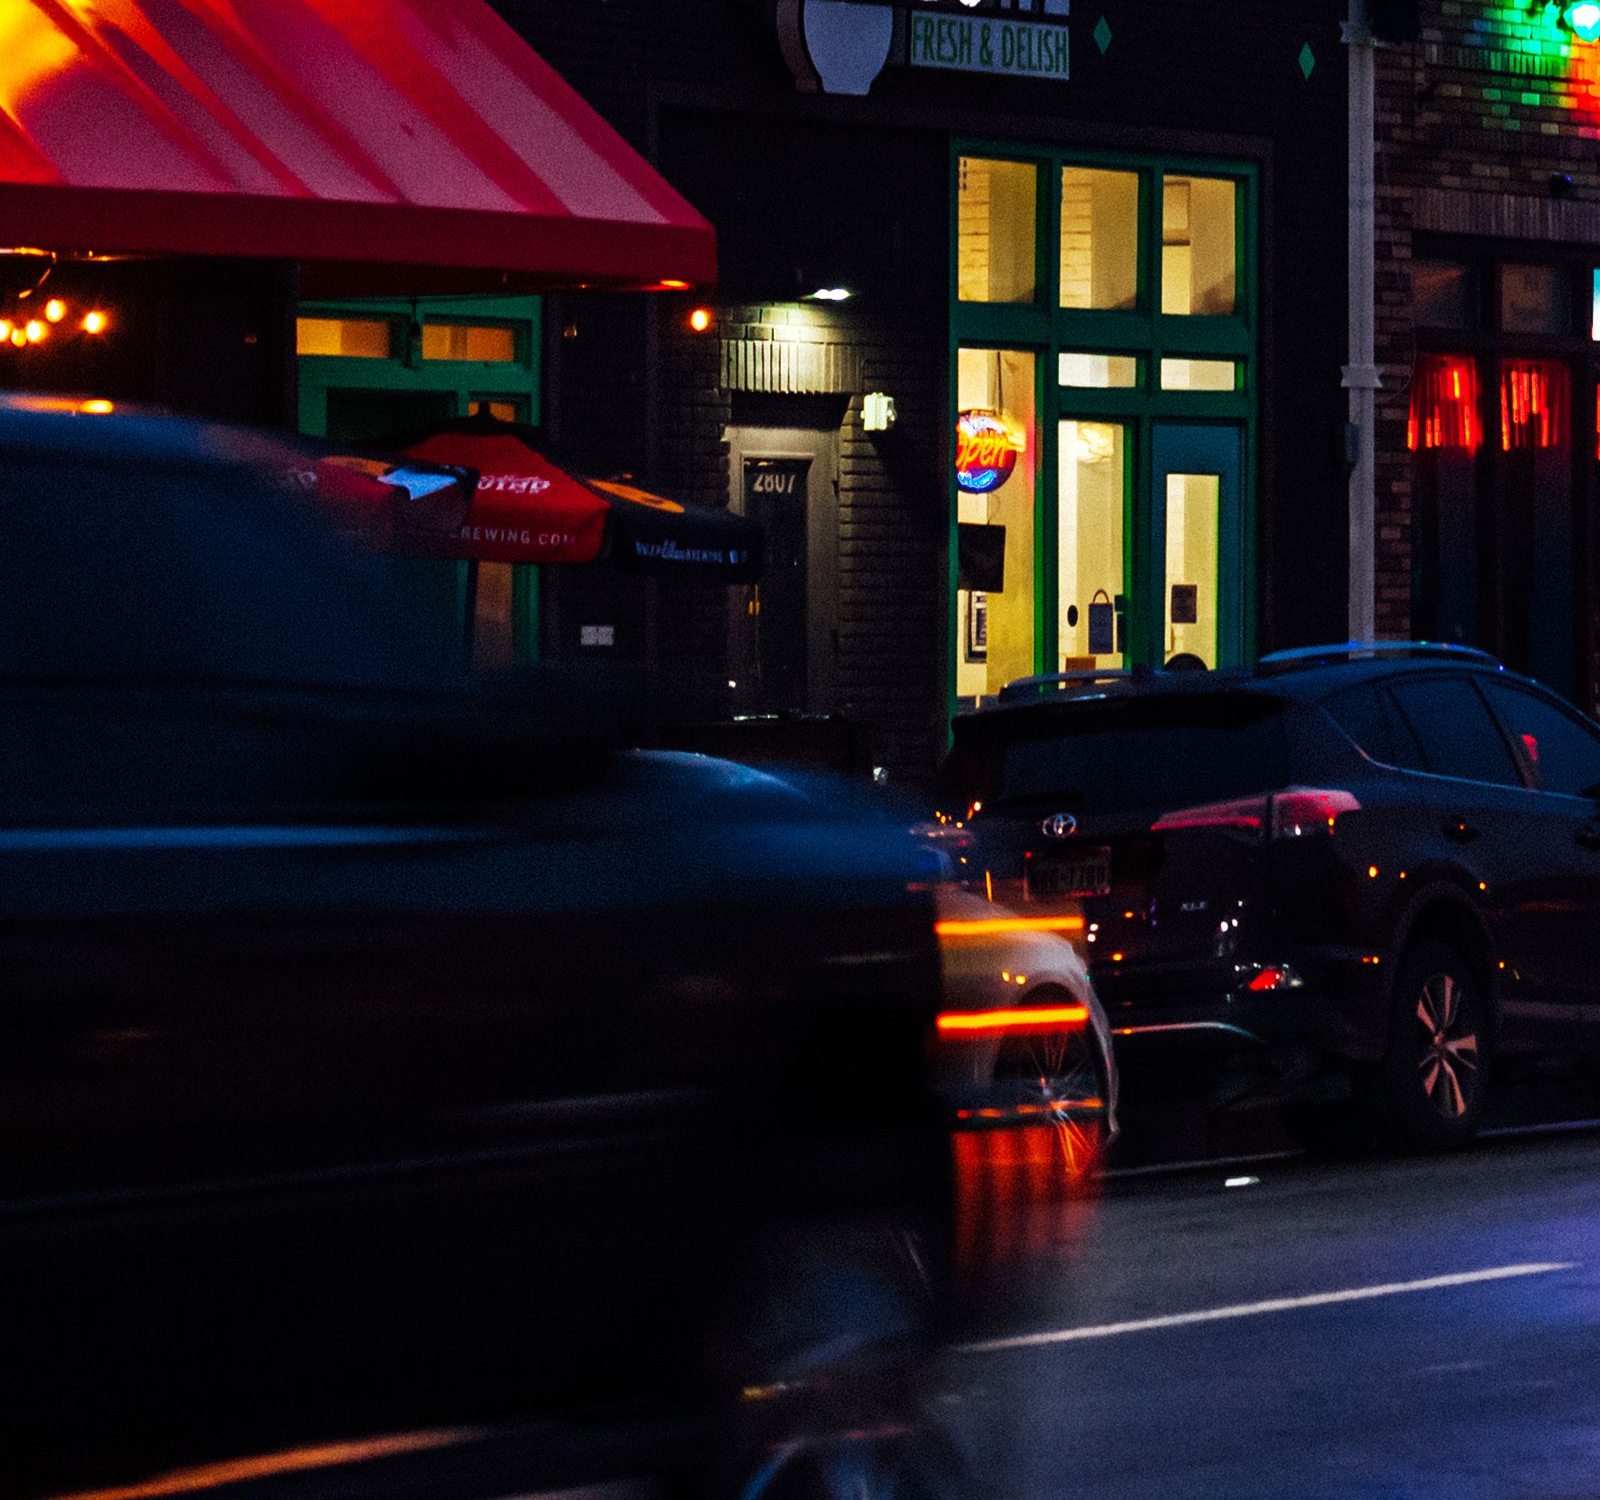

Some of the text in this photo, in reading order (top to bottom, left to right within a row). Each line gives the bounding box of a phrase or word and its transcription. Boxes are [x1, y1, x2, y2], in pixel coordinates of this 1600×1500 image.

[911, 16, 1069, 73] FRESH & DELISH
